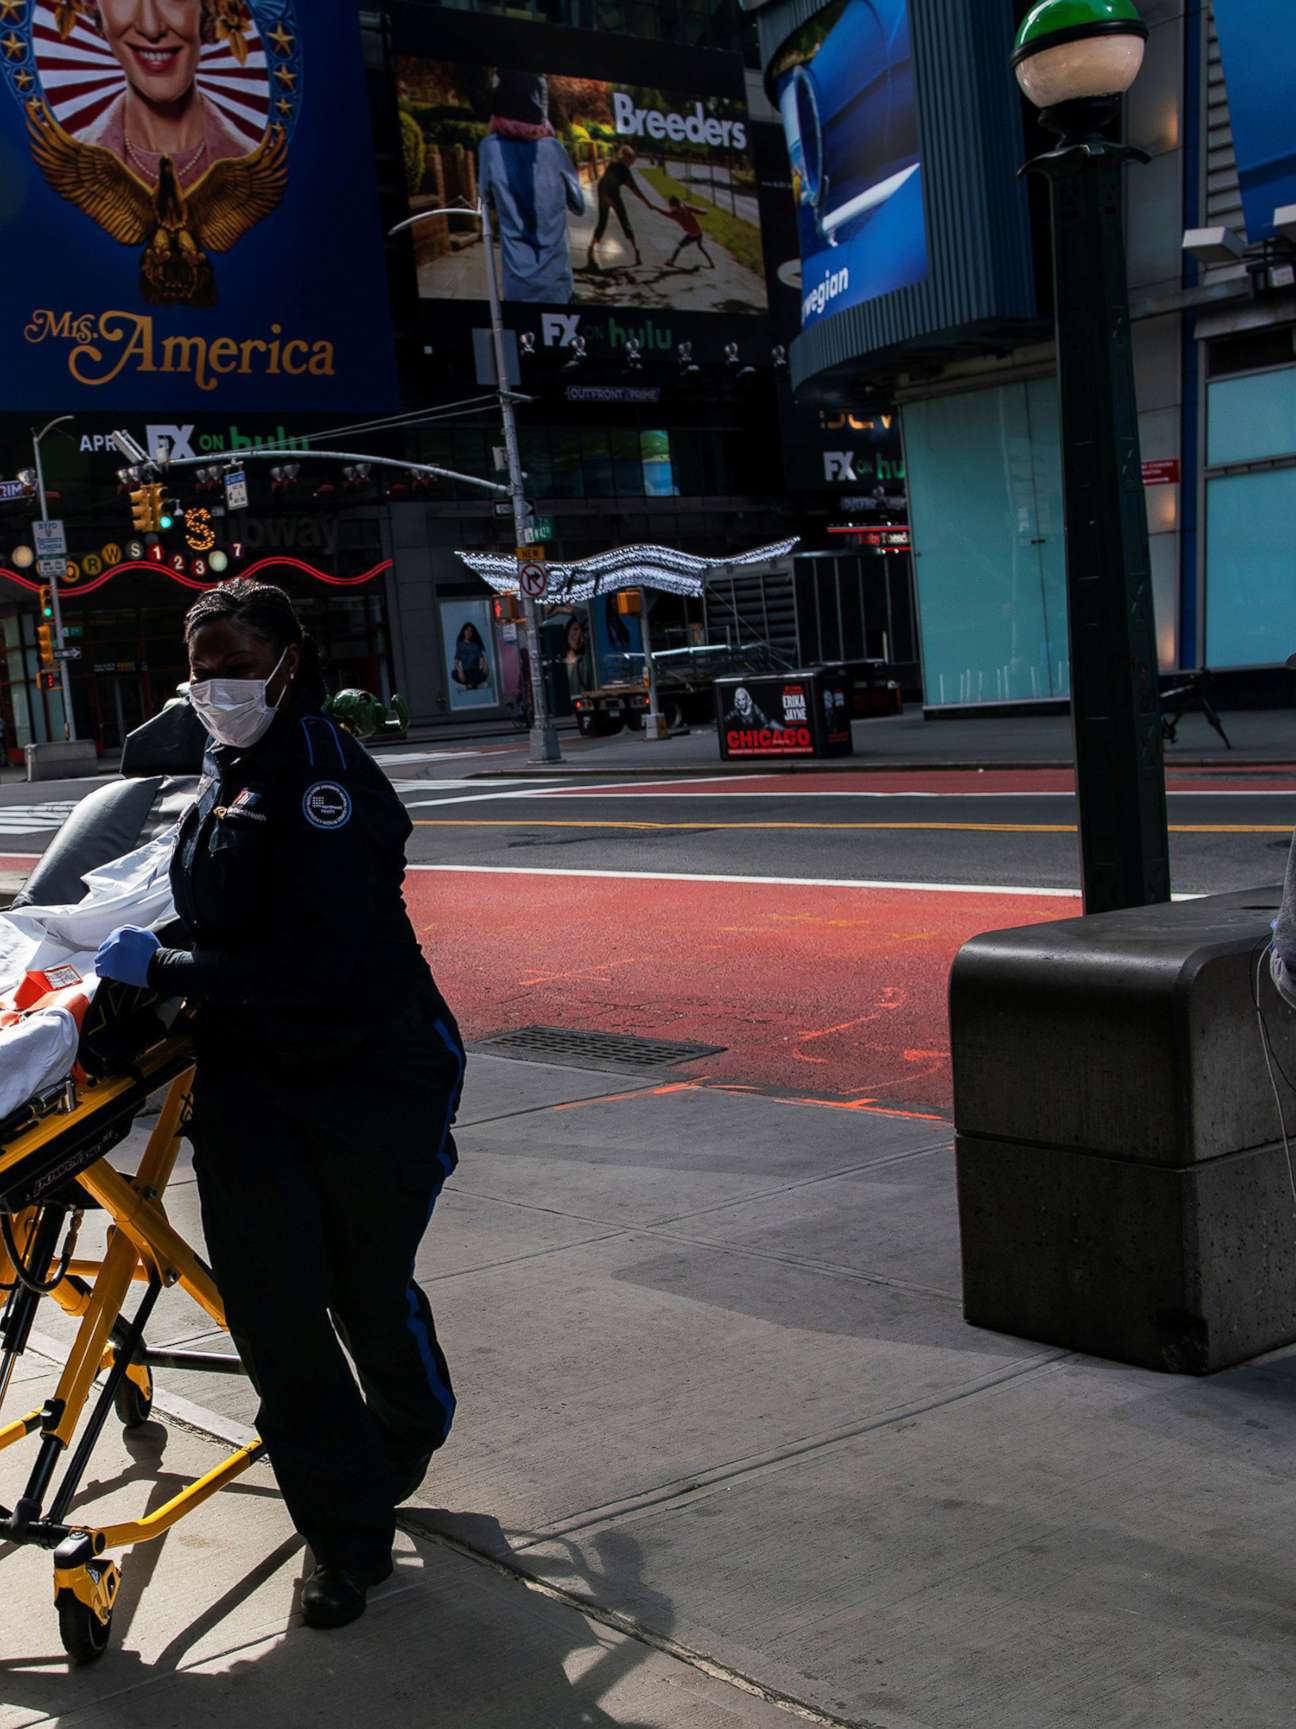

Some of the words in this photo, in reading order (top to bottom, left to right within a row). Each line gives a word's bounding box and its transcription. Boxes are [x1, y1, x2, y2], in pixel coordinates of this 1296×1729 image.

[613, 93, 747, 149] Breeders
[541, 312, 581, 348] FX
[608, 317, 673, 350] hulu
[24, 309, 98, 344] Mrs.
[68, 310, 335, 390] America
[145, 425, 195, 461] FX
[199, 435, 224, 451] ON
[823, 451, 857, 482] FX
[783, 694, 806, 709] ERIKA
[784, 707, 808, 721] JAYNE
[727, 728, 811, 749] CHICAGO
